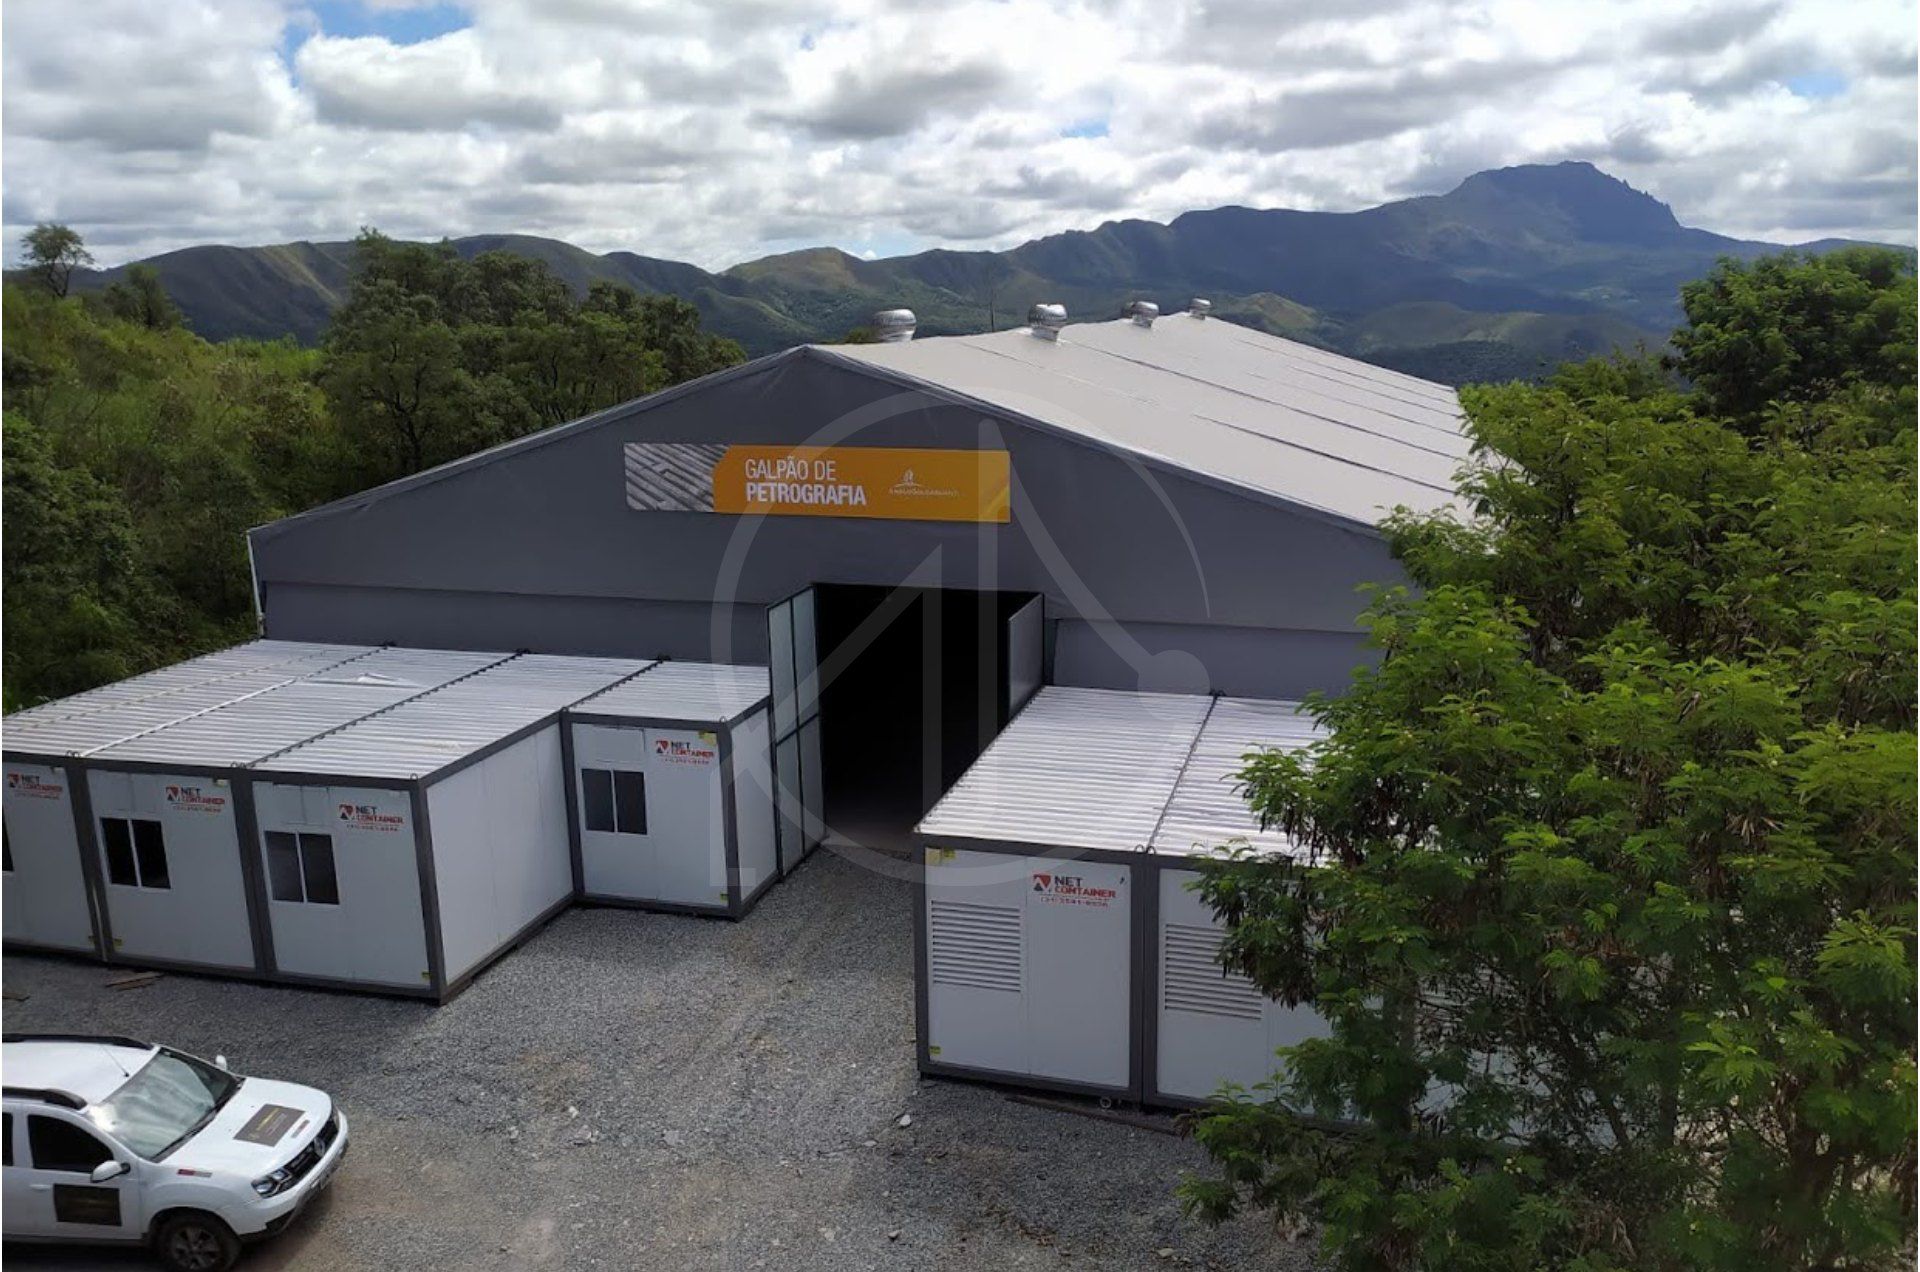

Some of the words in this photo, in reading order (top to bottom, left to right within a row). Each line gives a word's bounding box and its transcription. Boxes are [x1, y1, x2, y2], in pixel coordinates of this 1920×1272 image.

[745, 456, 809, 480] GALPÃO
[814, 460, 837, 481] DE
[746, 482, 867, 506] PETROGRAFIA
[671, 742, 690, 752] NET
[355, 805, 377, 815] NET
[357, 814, 403, 824] CONTAINER
[1054, 875, 1083, 887] NET
[1055, 886, 1117, 898] CONTAINER
